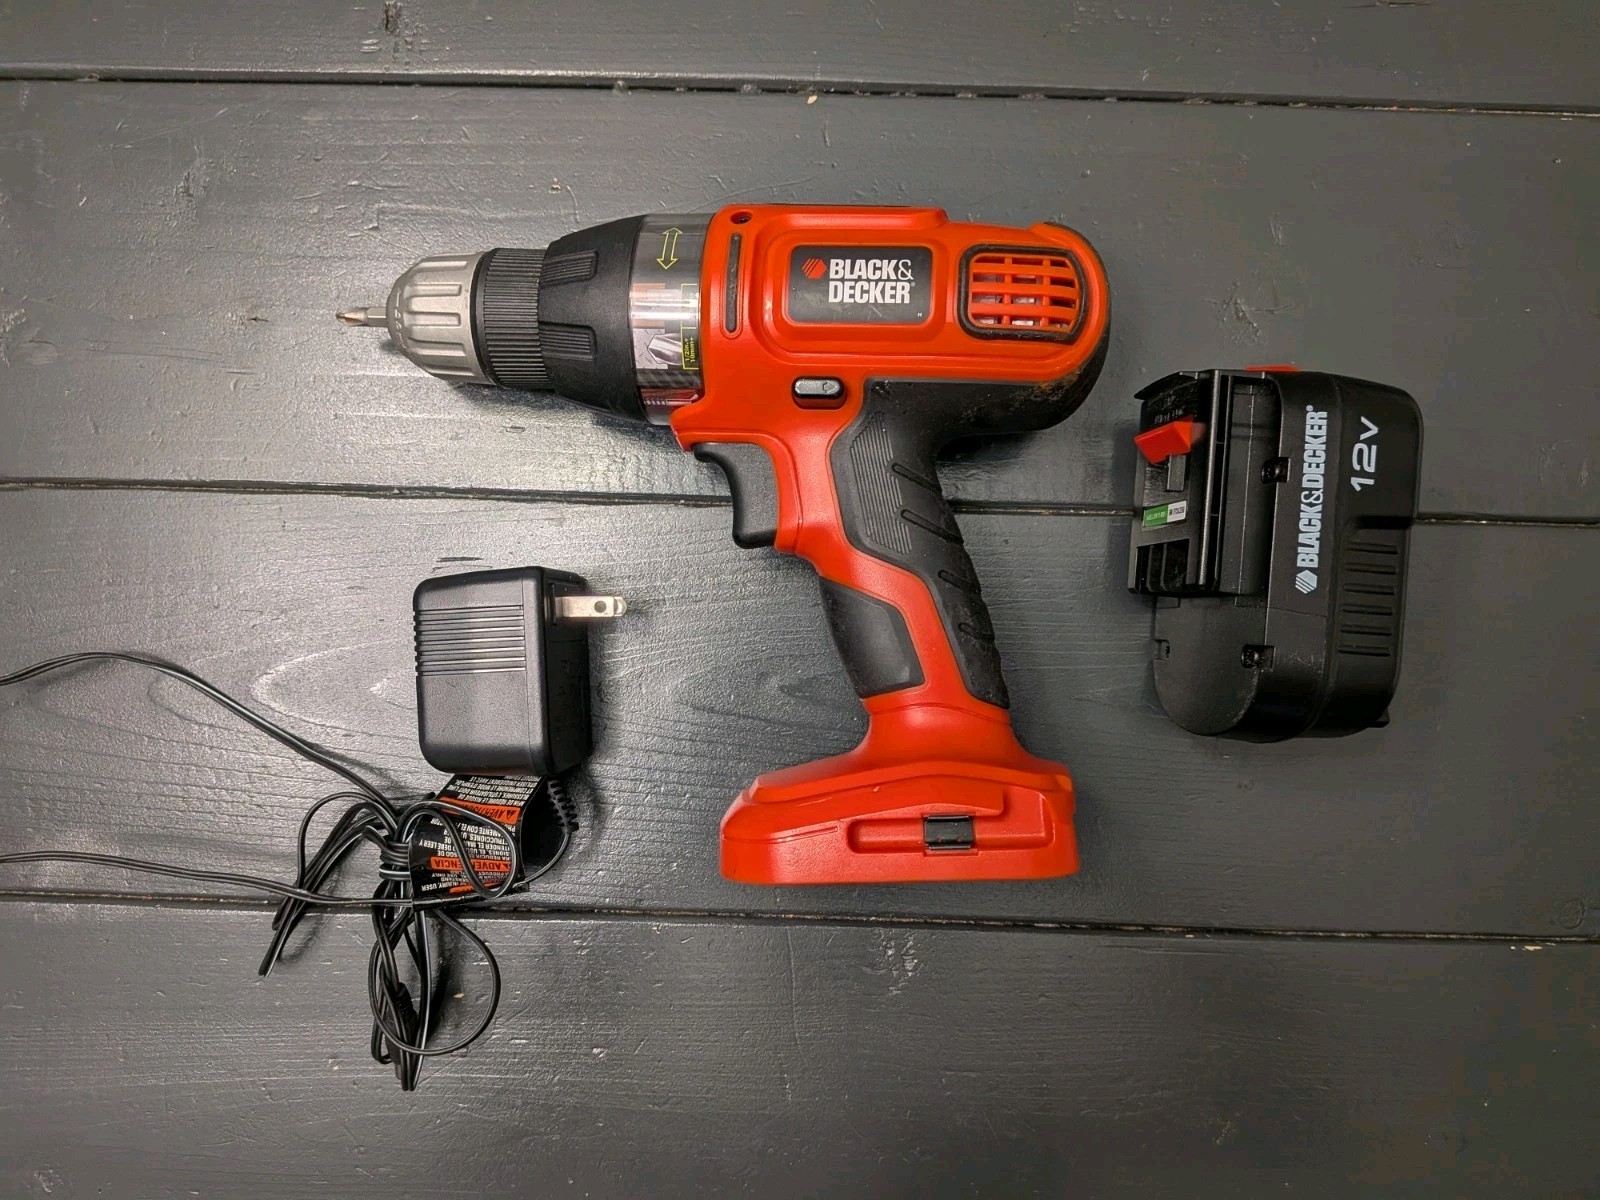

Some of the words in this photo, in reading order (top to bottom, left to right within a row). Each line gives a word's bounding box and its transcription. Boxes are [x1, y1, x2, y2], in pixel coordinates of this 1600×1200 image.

[830, 258, 914, 280] BLACK&
[1296, 411, 1328, 569] BLACK&DECKER
[434, 859, 501, 870] ADVEENCIA
[421, 883, 437, 891] USER
